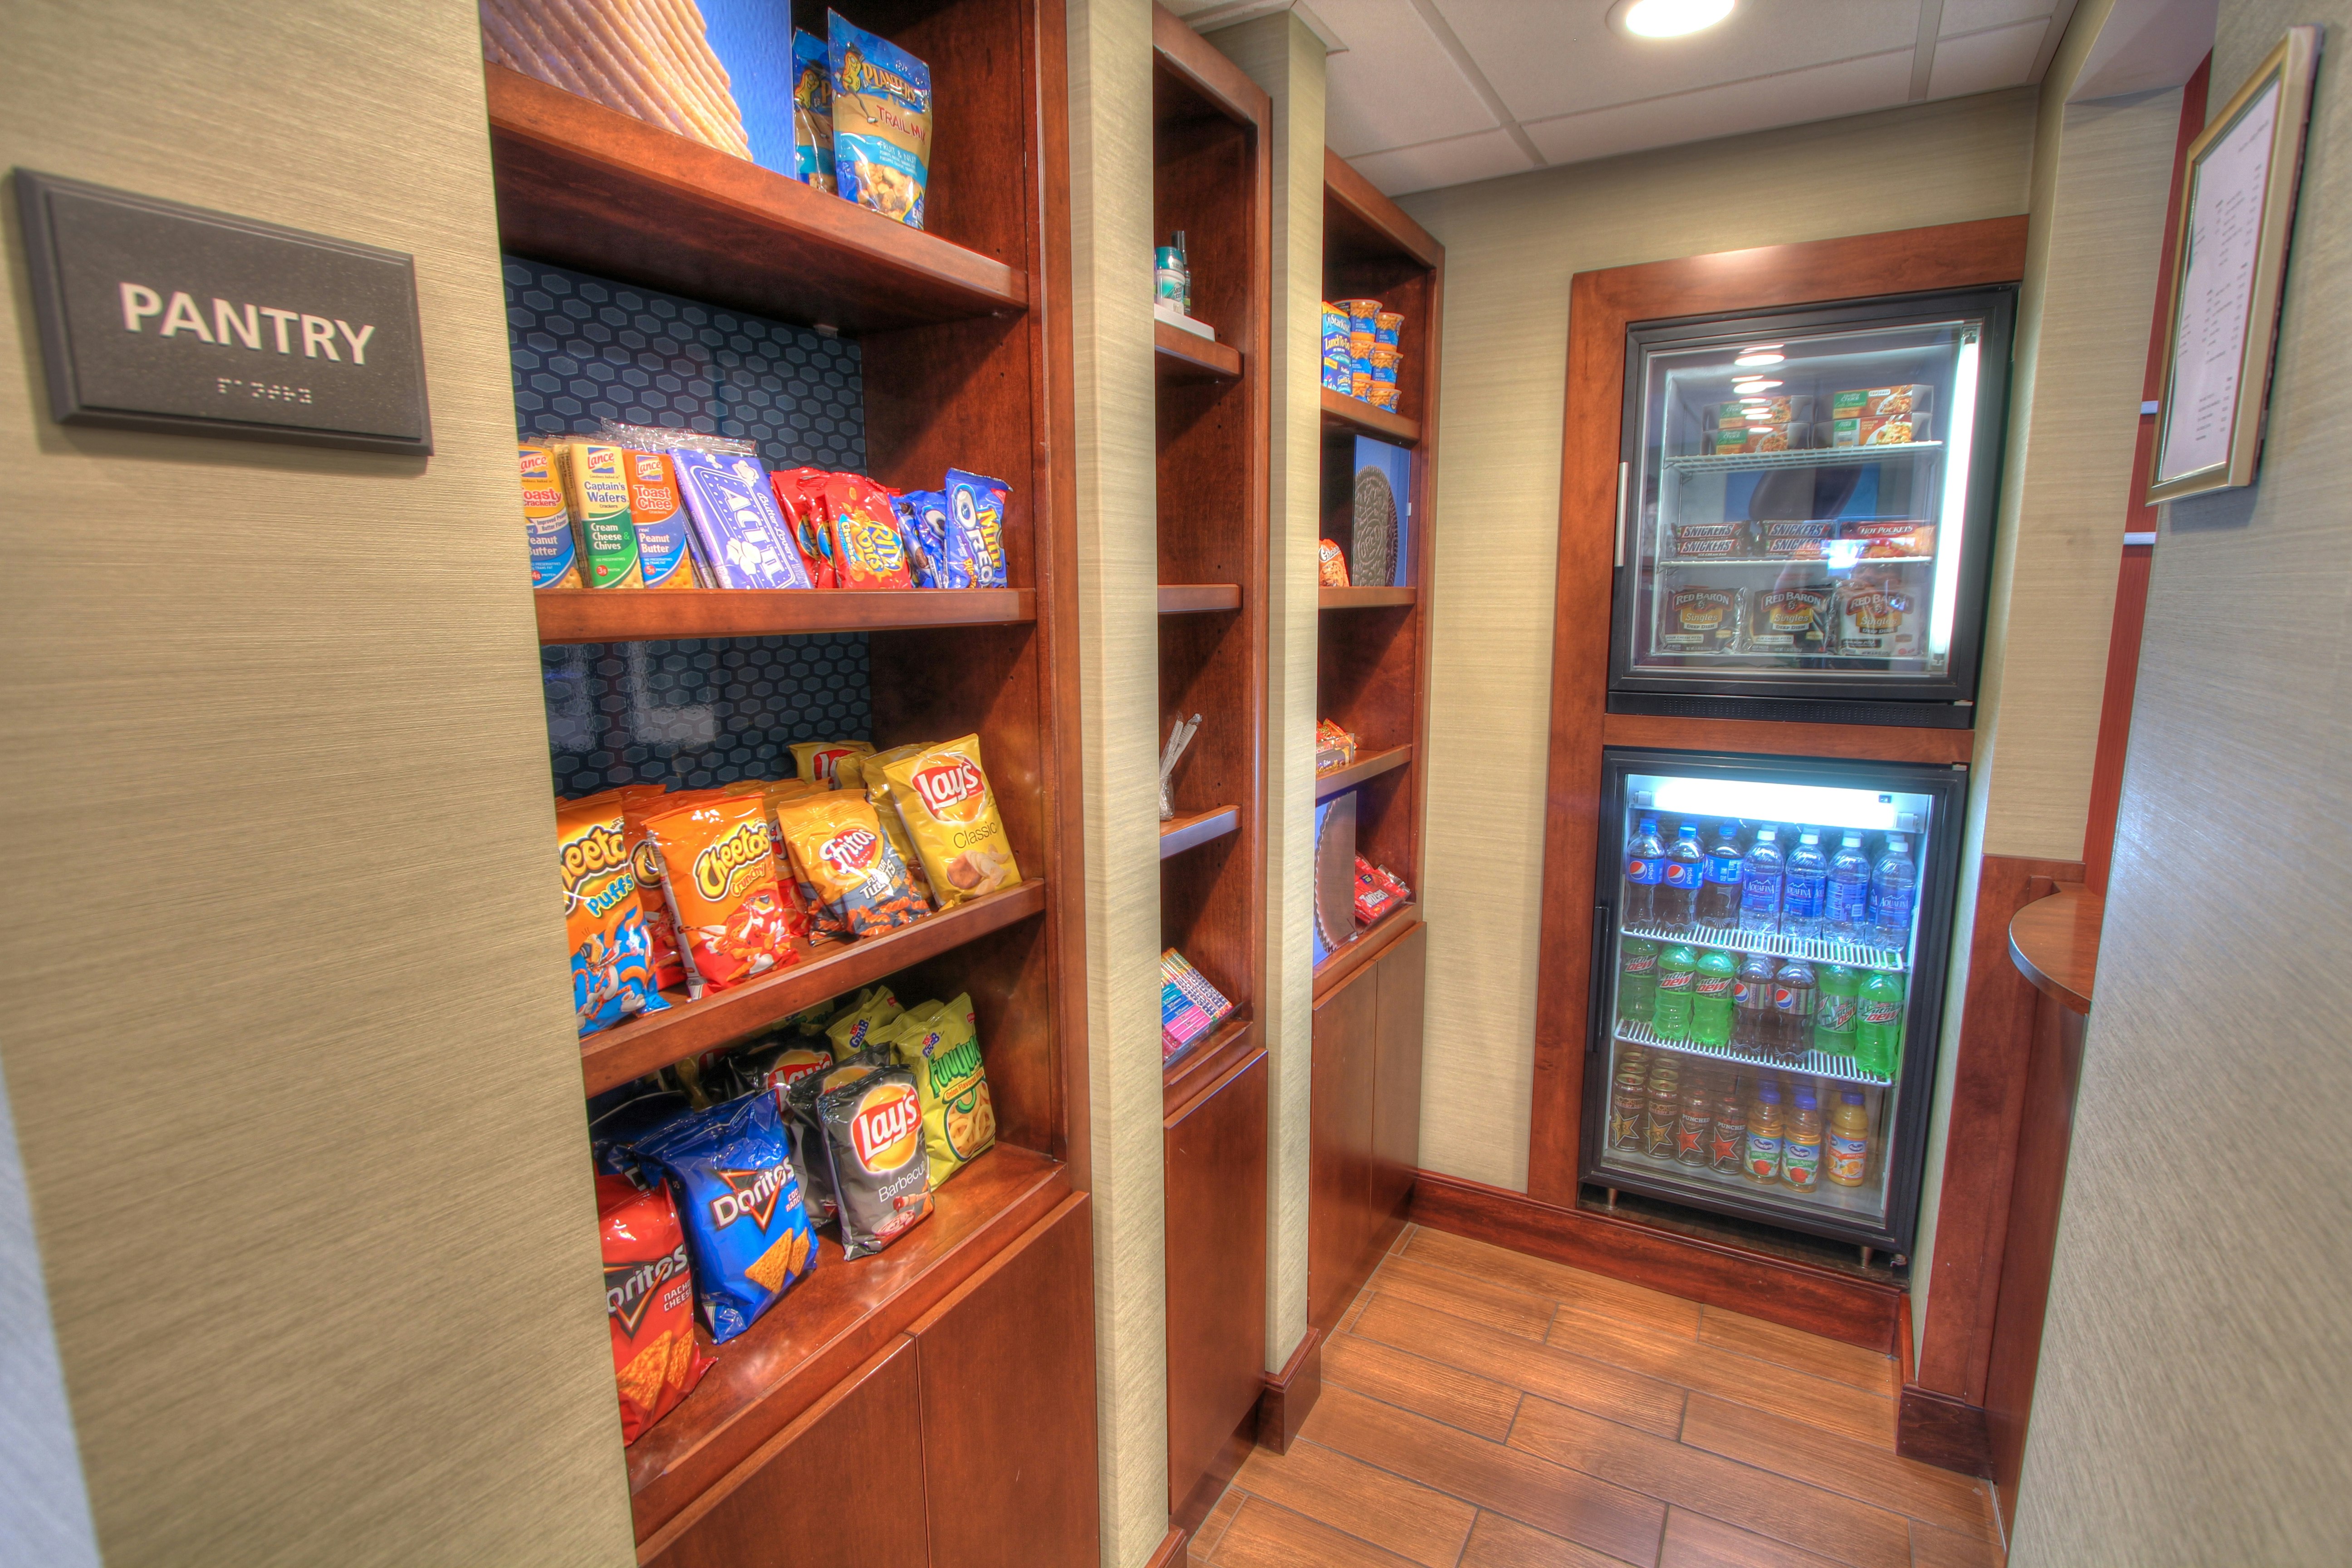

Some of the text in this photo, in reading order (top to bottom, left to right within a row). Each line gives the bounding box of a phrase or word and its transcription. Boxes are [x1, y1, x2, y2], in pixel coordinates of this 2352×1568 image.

[862, 63, 916, 102] PLANTERS
[877, 104, 925, 144] TRAIL MIX
[880, 141, 916, 163] FRUIT & NUT
[119, 282, 375, 366] PANTRY
[1331, 314, 1350, 333] StarKist
[520, 456, 548, 472] ance
[588, 453, 614, 470] Lance
[637, 461, 662, 475] Lance
[584, 481, 626, 491] Captain's
[634, 485, 671, 499] Toast
[523, 488, 562, 503] oasty
[587, 491, 627, 503] Wafers
[637, 497, 672, 510] Chee
[716, 484, 771, 544] ACT
[590, 523, 618, 531] Cream
[757, 492, 797, 563] Butter Lovers
[1683, 524, 1735, 537] SNICKERS
[1770, 524, 1824, 536] SNICKERS
[1861, 527, 1877, 535] HOT
[529, 536, 558, 544] eanut
[592, 532, 630, 541] Cheese &
[639, 533, 670, 543] Peanut
[956, 490, 994, 584] OREO
[976, 508, 1002, 569] Mini
[593, 541, 621, 550] Chives
[641, 544, 670, 553] Butter
[866, 521, 903, 571] RITZ
[1681, 540, 1733, 553] SNICKERS
[1676, 593, 1730, 606] RED BARON
[1765, 592, 1821, 607] RED BARON
[1850, 596, 1871, 609] RED
[1685, 613, 1718, 622] Singles
[1774, 613, 1809, 623] Singles
[1861, 616, 1898, 627] Singles
[918, 764, 979, 810] Lay's
[953, 821, 998, 849] Classic
[819, 829, 877, 874] Fritos
[697, 825, 770, 897] Cheetos
[730, 862, 765, 897] Crunchy
[586, 874, 634, 916] Puffs
[1748, 882, 1774, 893] AQUAFINA
[849, 1023, 859, 1036] BIG
[849, 1019, 869, 1049] GRAB
[922, 1034, 933, 1046] BIG
[946, 1088, 959, 1099] Onion
[958, 1075, 976, 1091] Flavored
[1682, 1113, 1710, 1123] PUNCHED
[858, 1093, 918, 1161] Lay's
[1717, 1121, 1746, 1131] PUNCHED
[878, 1161, 927, 1203] Barbecue
[712, 1155, 795, 1228] Doritos
[607, 1244, 688, 1313] oritos
[664, 1279, 692, 1302] NACHO
